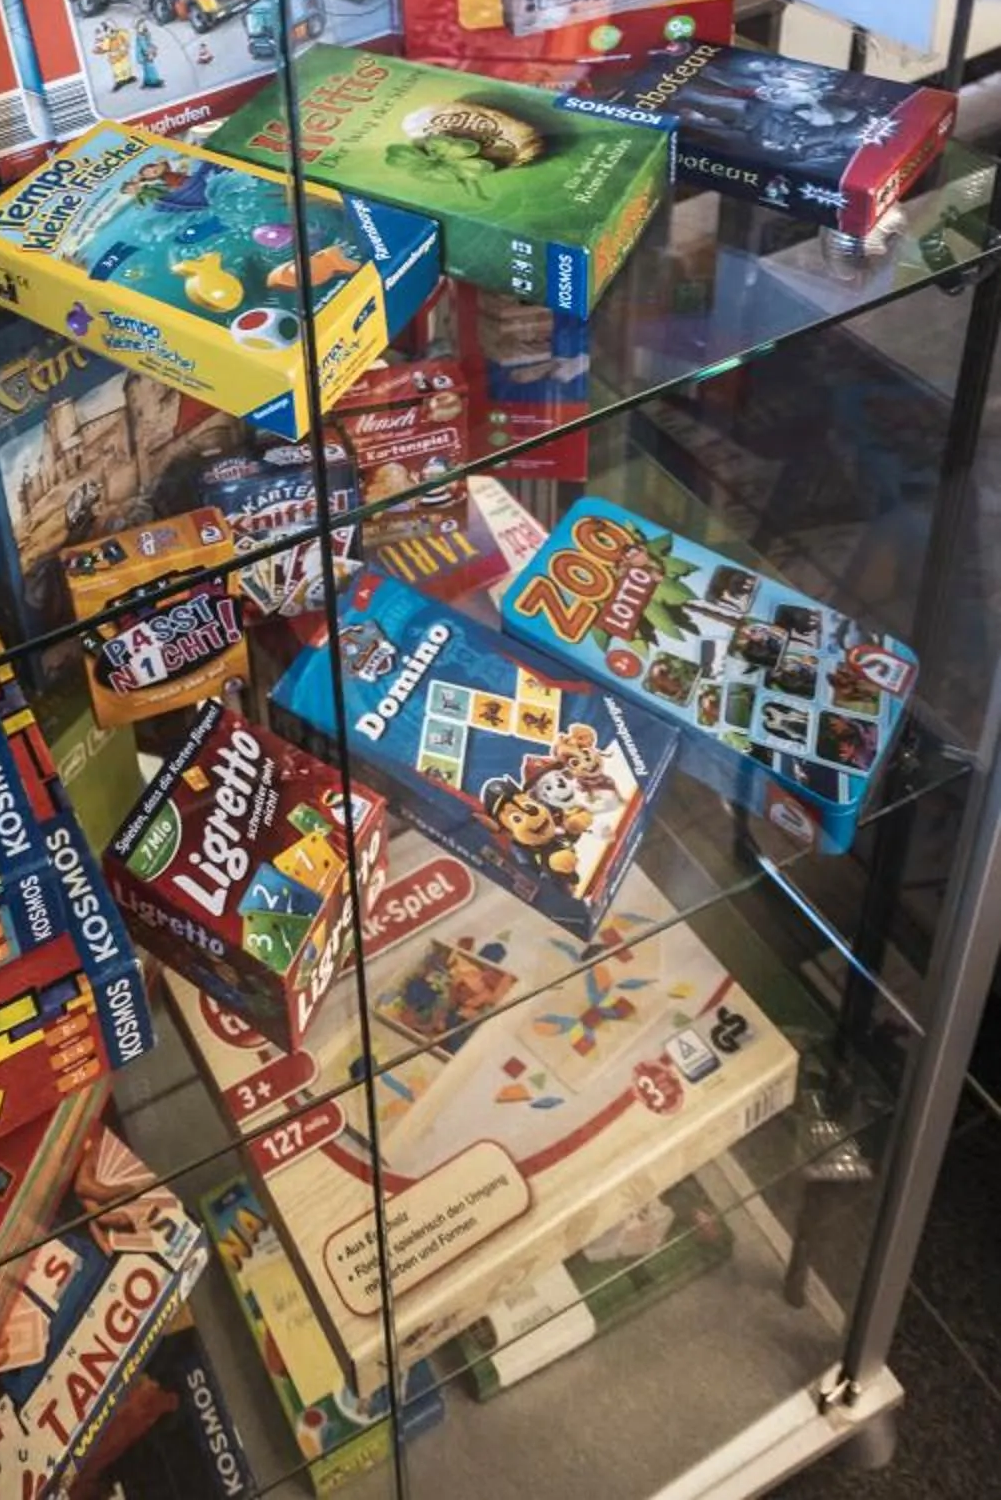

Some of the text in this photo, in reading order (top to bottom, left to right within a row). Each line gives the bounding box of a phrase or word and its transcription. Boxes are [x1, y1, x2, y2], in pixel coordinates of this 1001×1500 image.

[565, 96, 665, 126] KOSMOS
[635, 44, 722, 113] aboteur
[23, 134, 150, 252] kleine Fische!
[679, 152, 760, 187] oteur
[557, 253, 575, 310] KOSMOS
[355, 407, 417, 434] Mensch
[365, 432, 451, 461] Kartenspiel
[241, 484, 318, 514] KARTE
[515, 515, 638, 645] ZOO
[605, 566, 653, 632] LOTTO
[355, 623, 452, 741] Domino
[173, 729, 262, 918] Ligretto
[19, 874, 53, 942] KOSMOS
[44, 826, 120, 965] KOSMOS
[253, 883, 280, 909] 2
[105, 978, 146, 1063] KOSMOS
[239, 1078, 273, 1108] 3+
[35, 1266, 162, 1448] TANGO
[186, 1367, 244, 1498] KOSMOS
